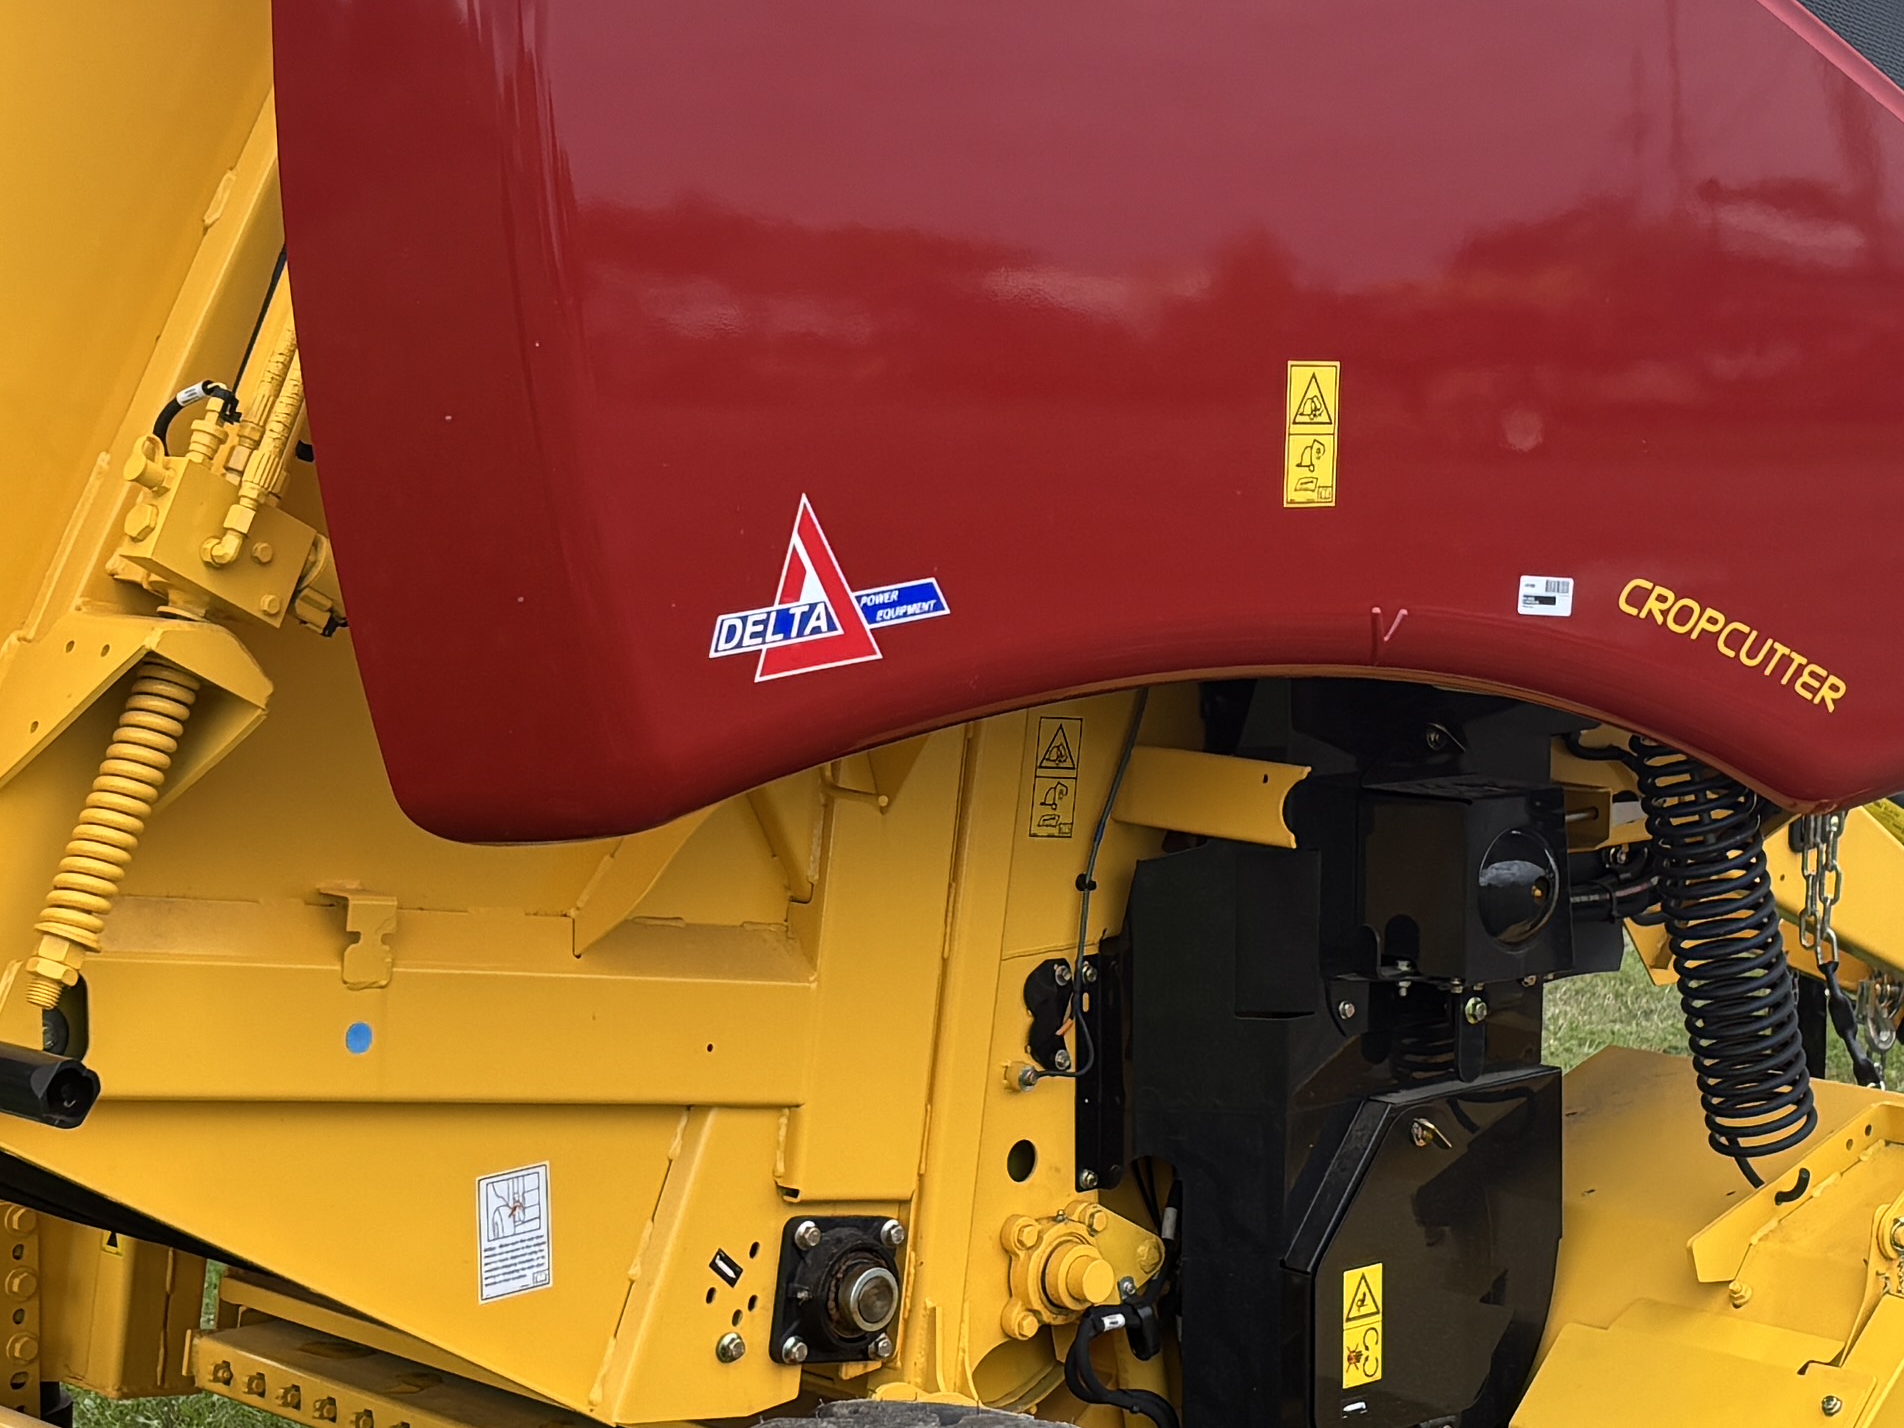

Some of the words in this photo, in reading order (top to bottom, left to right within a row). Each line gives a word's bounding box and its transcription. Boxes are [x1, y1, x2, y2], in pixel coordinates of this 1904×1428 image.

[860, 590, 899, 608] POWER
[876, 599, 938, 622] EQUIPMENT
[717, 602, 828, 651] DELTA
[1618, 578, 1848, 714] CROPCUTTER
